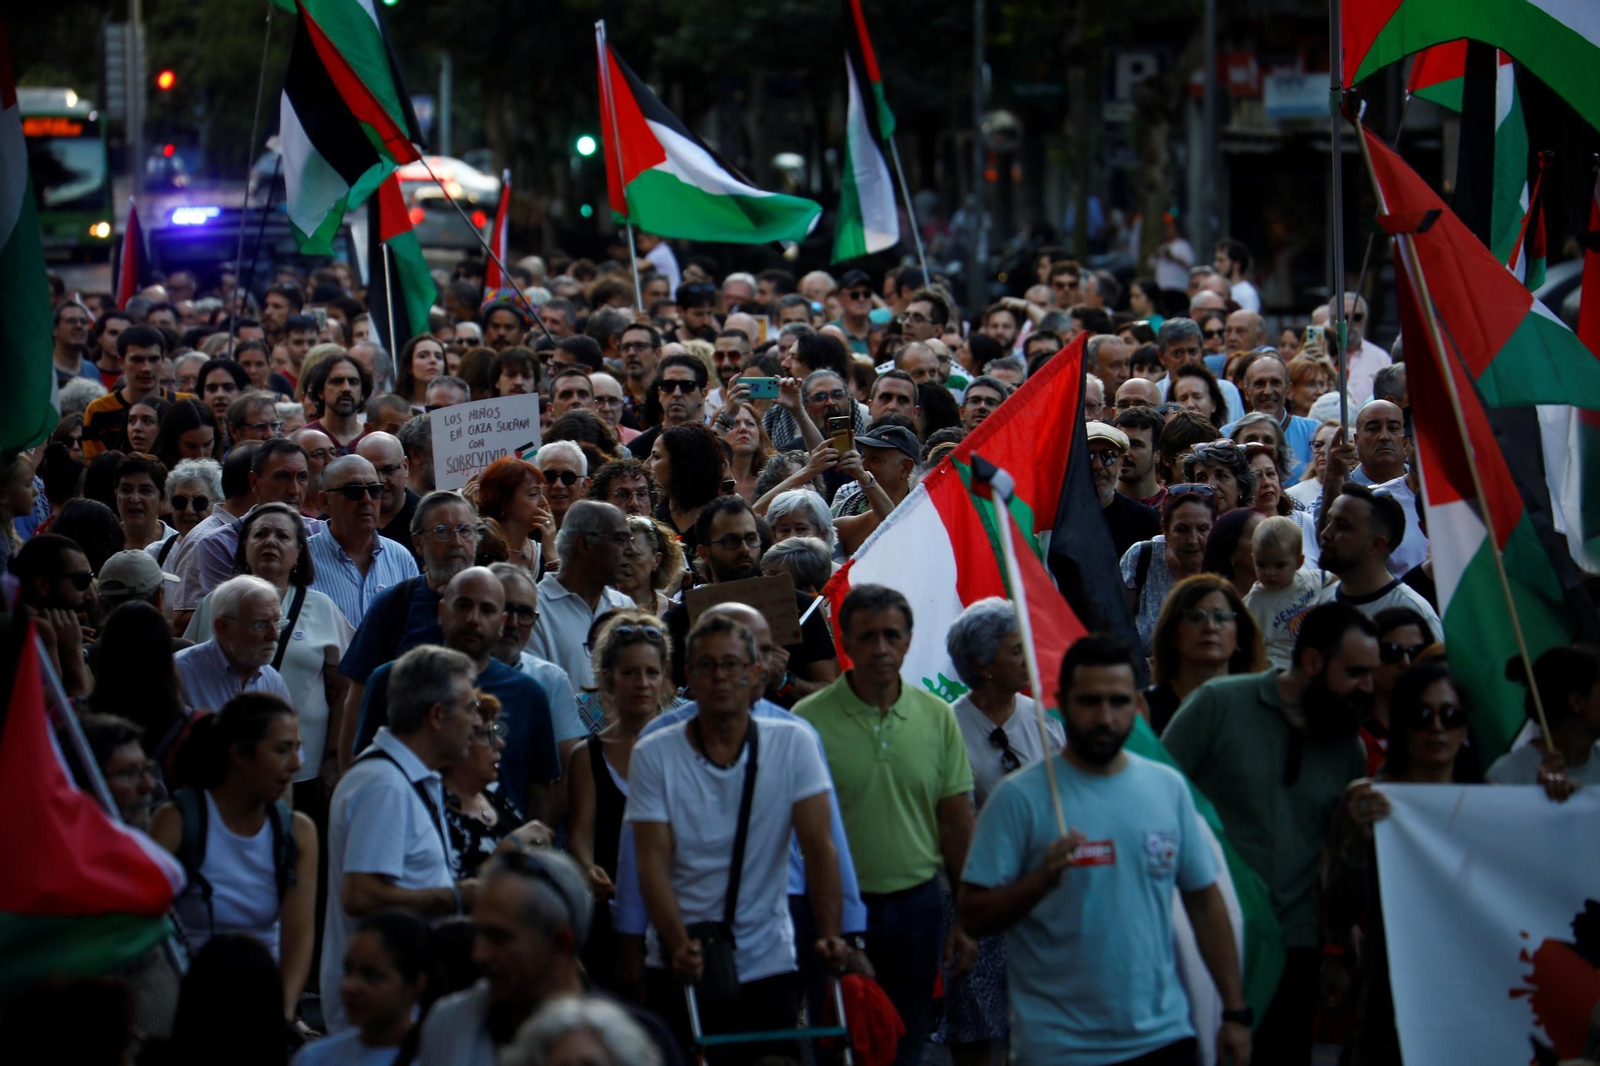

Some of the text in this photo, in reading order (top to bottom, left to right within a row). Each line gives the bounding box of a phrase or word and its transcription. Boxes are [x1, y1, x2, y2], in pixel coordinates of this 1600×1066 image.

[444, 406, 501, 426] LOS NIÑOS
[450, 418, 530, 441] EN GAZA SUEÑAN
[468, 438, 485, 449] CON
